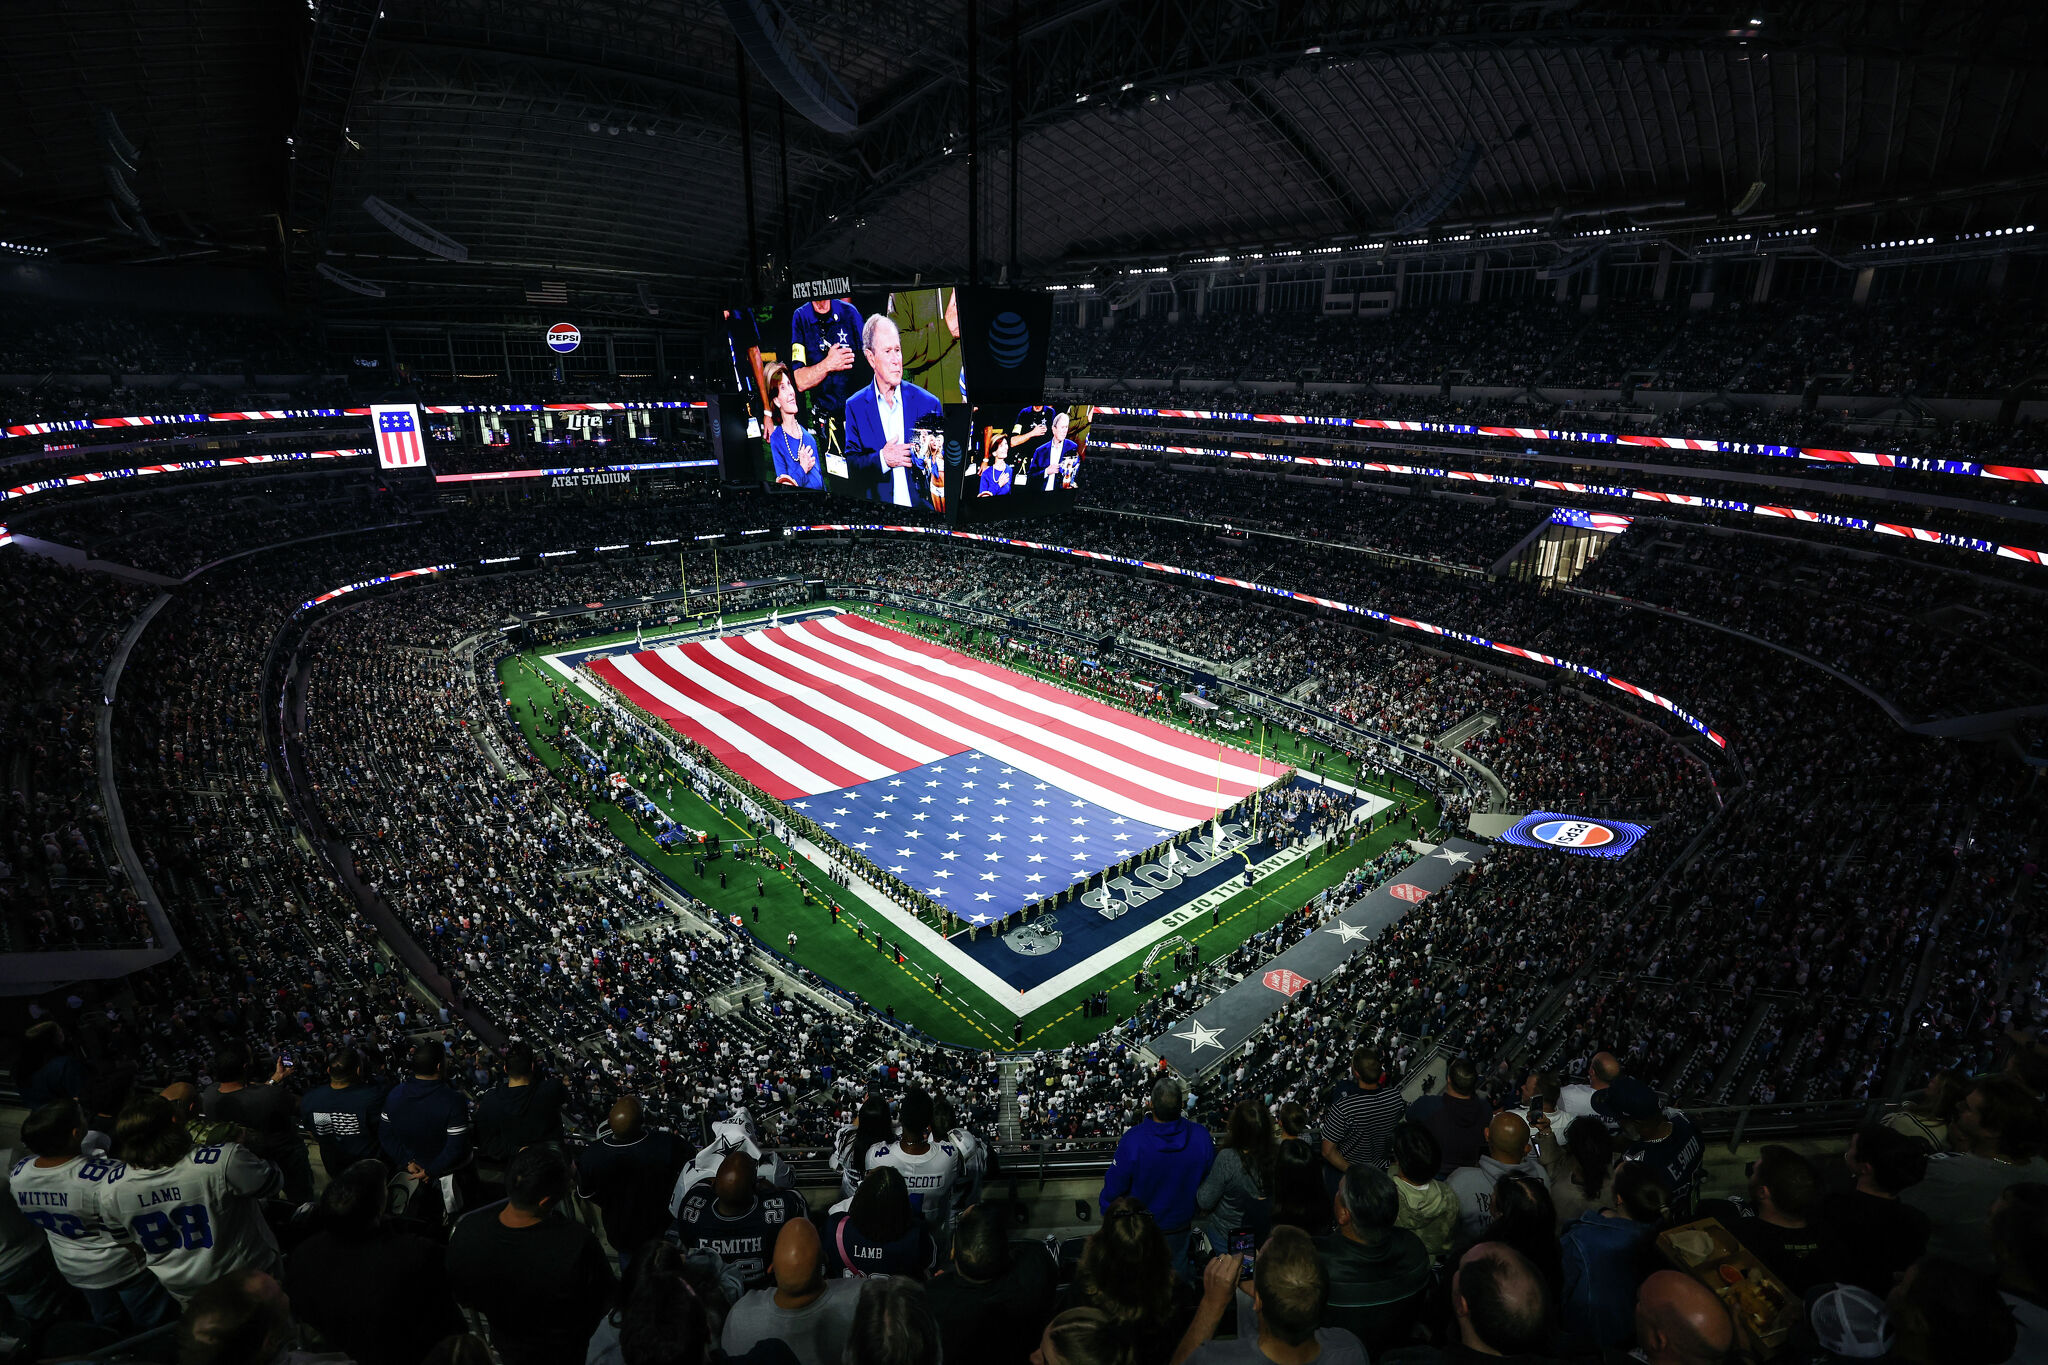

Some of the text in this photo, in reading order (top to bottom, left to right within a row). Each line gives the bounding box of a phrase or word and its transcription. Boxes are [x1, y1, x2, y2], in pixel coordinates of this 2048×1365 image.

[792, 277, 850, 299] AT&T STADIUM
[549, 334, 579, 342] PEPSI
[566, 414, 602, 430] Lite
[551, 472, 631, 488] AT&T STADIUM
[1555, 823, 1590, 845] PEPSI
[1252, 855, 1290, 882] TAKE
[1211, 880, 1243, 899] ALL
[1191, 899, 1213, 913] OF
[1162, 912, 1189, 928] US
[874, 1146, 890, 1158] 4
[1667, 1136, 1701, 1181] E. SMITH
[903, 1175, 942, 1188] SCOTT
[17, 1191, 68, 1207] WITTEN
[137, 1186, 182, 1208] LAMB
[683, 1195, 707, 1224] 22
[763, 1197, 785, 1224] 22
[131, 1203, 214, 1255] 88
[712, 1236, 762, 1255] SMITH
[854, 1245, 883, 1259] LAMB
